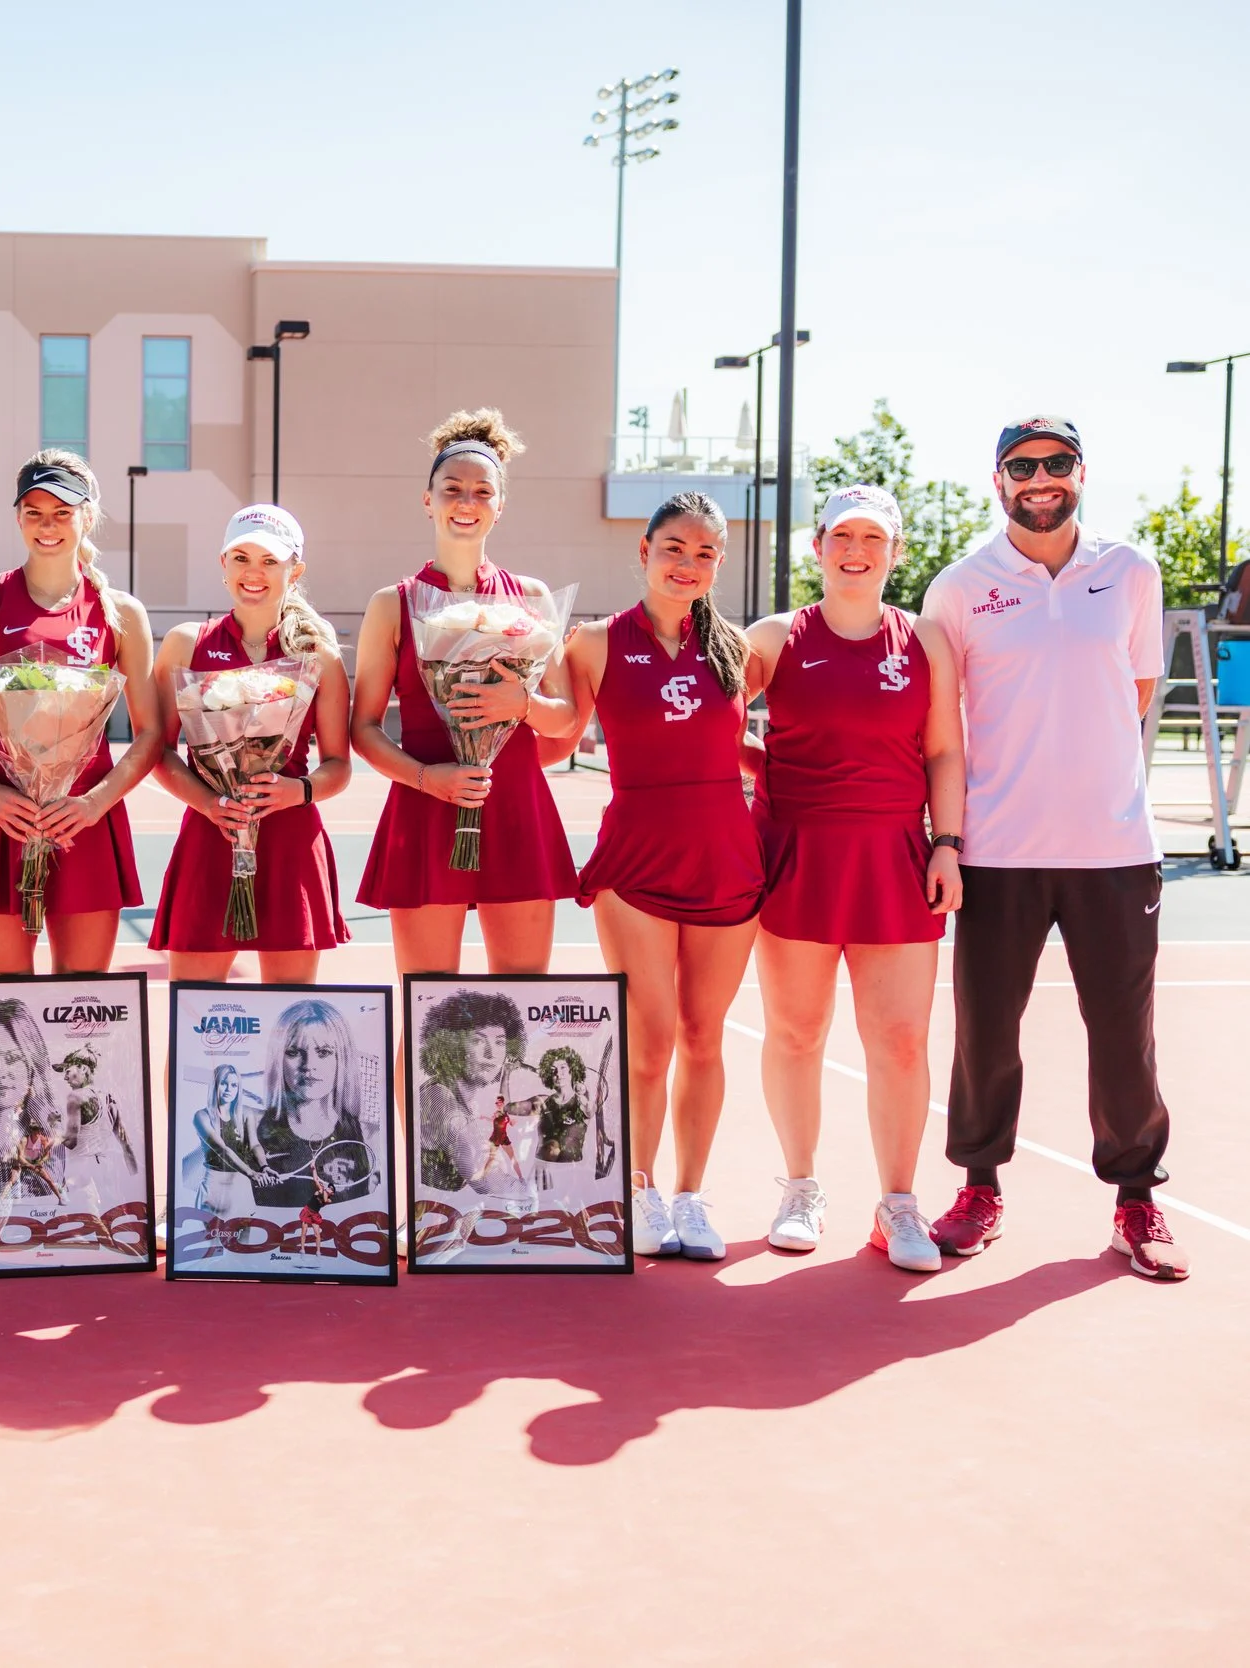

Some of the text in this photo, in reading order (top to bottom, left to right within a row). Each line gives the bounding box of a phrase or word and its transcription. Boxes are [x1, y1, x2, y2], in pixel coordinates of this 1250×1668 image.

[972, 597, 1022, 615] SANTA CLARA
[527, 1005, 612, 1023] DANIELLA
[193, 1016, 261, 1035] JAMIE
[29, 1208, 57, 1219] Class of
[173, 1206, 391, 1267] 2026
[210, 1228, 244, 1240] Class of
[414, 1200, 626, 1258] 2026
